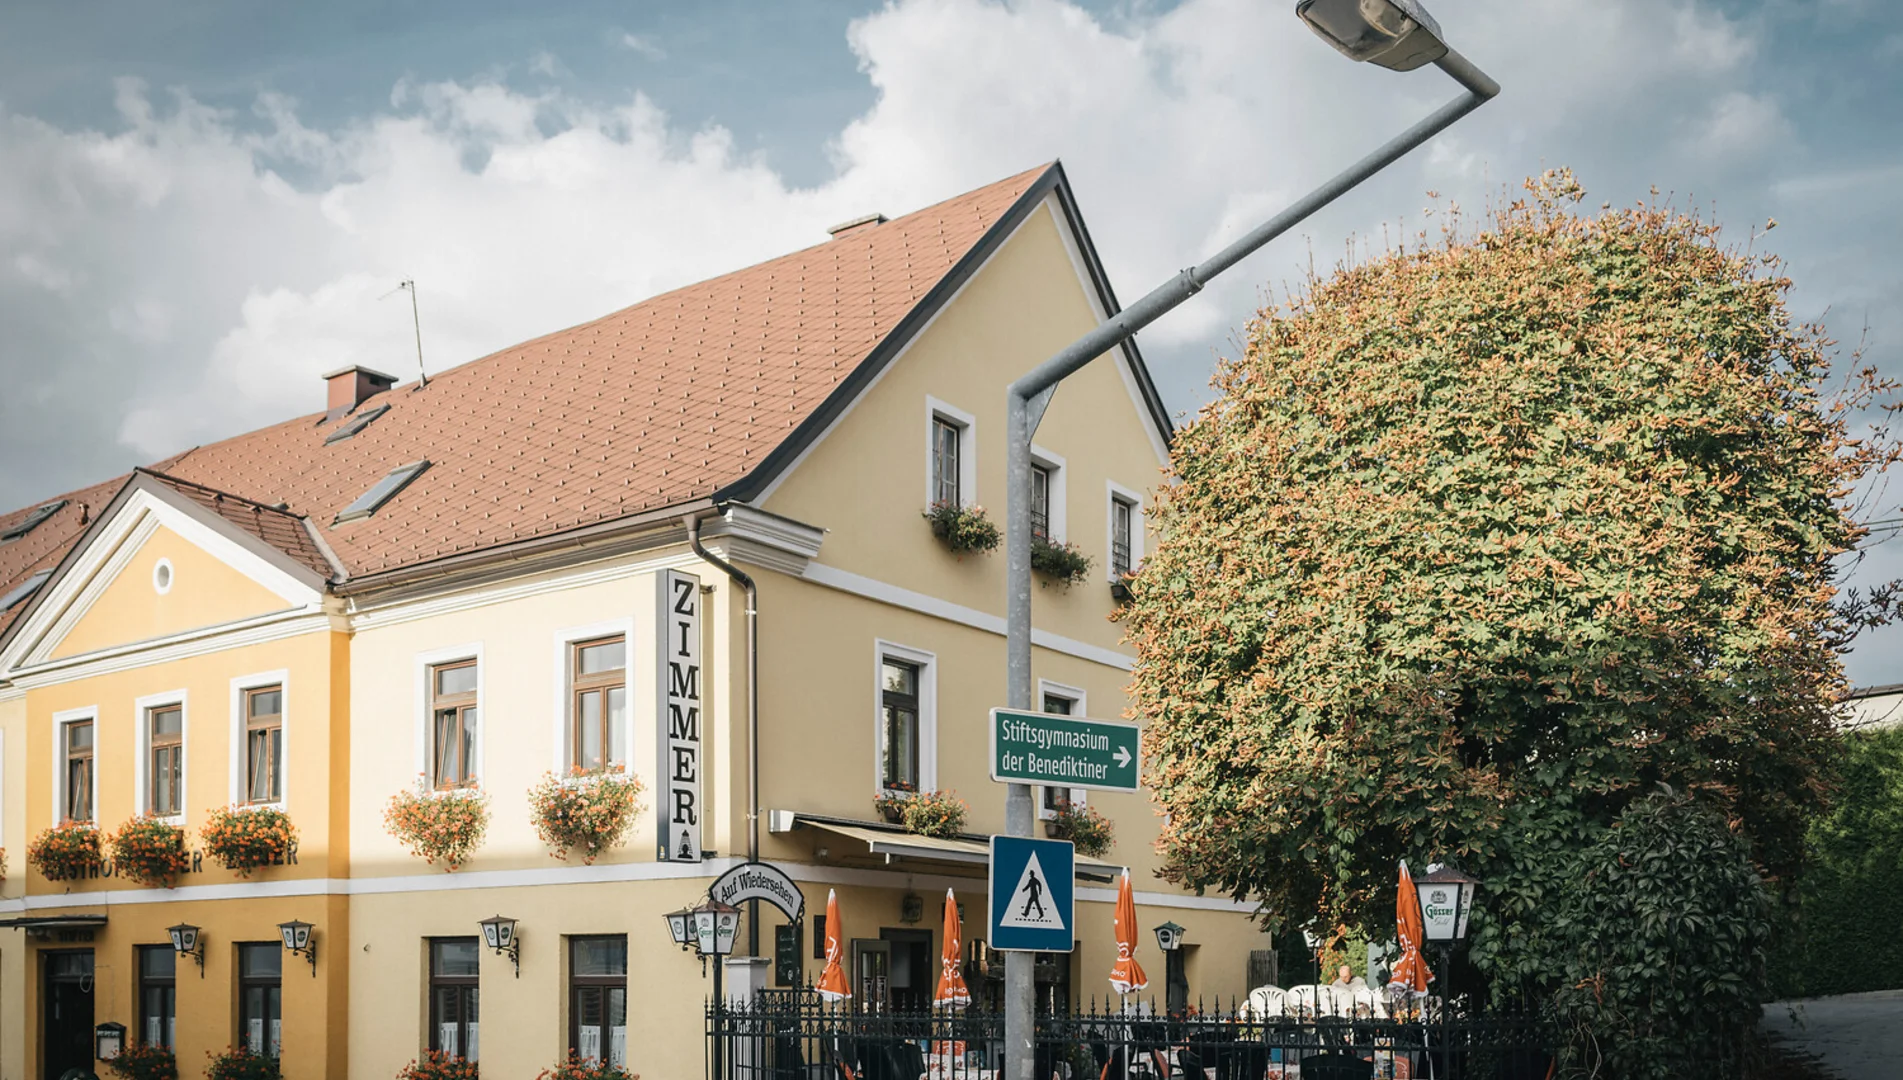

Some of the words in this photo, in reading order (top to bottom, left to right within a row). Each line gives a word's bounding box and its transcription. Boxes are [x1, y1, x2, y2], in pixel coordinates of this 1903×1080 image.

[669, 578, 699, 826] ZIMMER
[1002, 719, 1109, 751] Stiftsgymnasium
[1002, 750, 1024, 772] der
[1028, 752, 1108, 780] Benediktiner
[721, 877, 738, 901] Auf
[738, 871, 794, 908] Wiedersehen
[1425, 904, 1454, 919] Gösser
